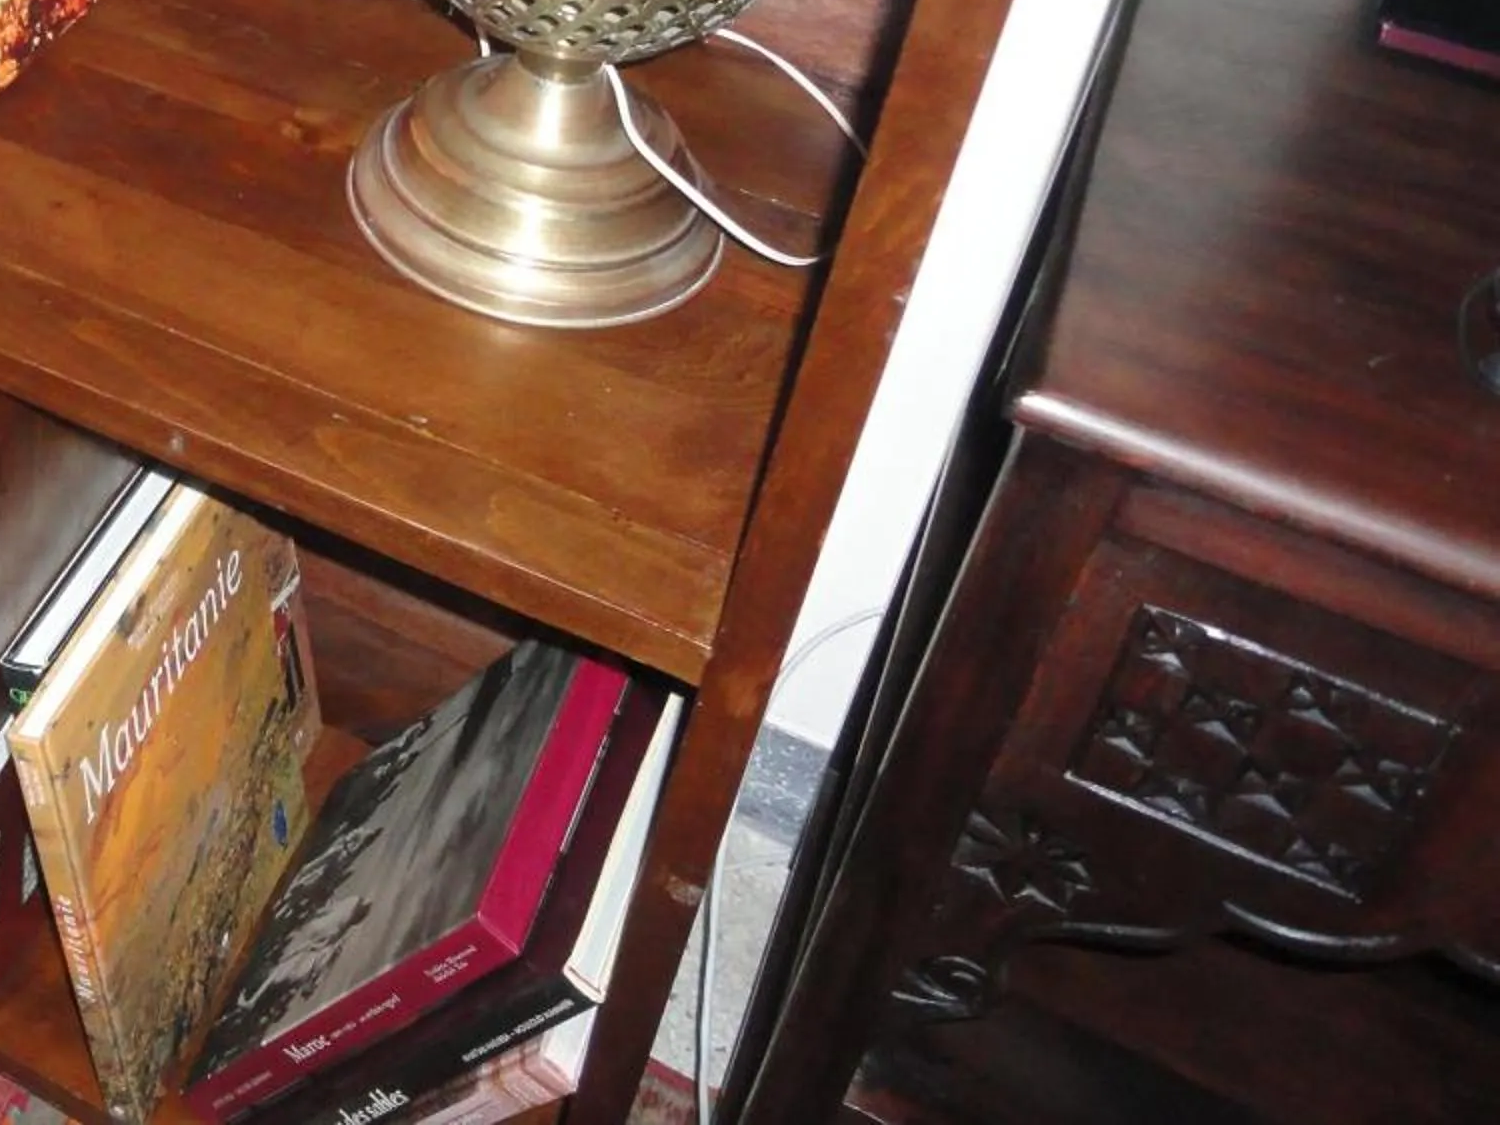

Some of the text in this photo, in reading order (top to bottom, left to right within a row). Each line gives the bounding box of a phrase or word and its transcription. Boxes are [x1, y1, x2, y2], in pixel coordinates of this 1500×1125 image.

[79, 549, 243, 825] Mauritanie
[55, 894, 96, 1003] Mauritanie
[283, 1034, 332, 1064] Maroc
[365, 1087, 410, 1119] sables
